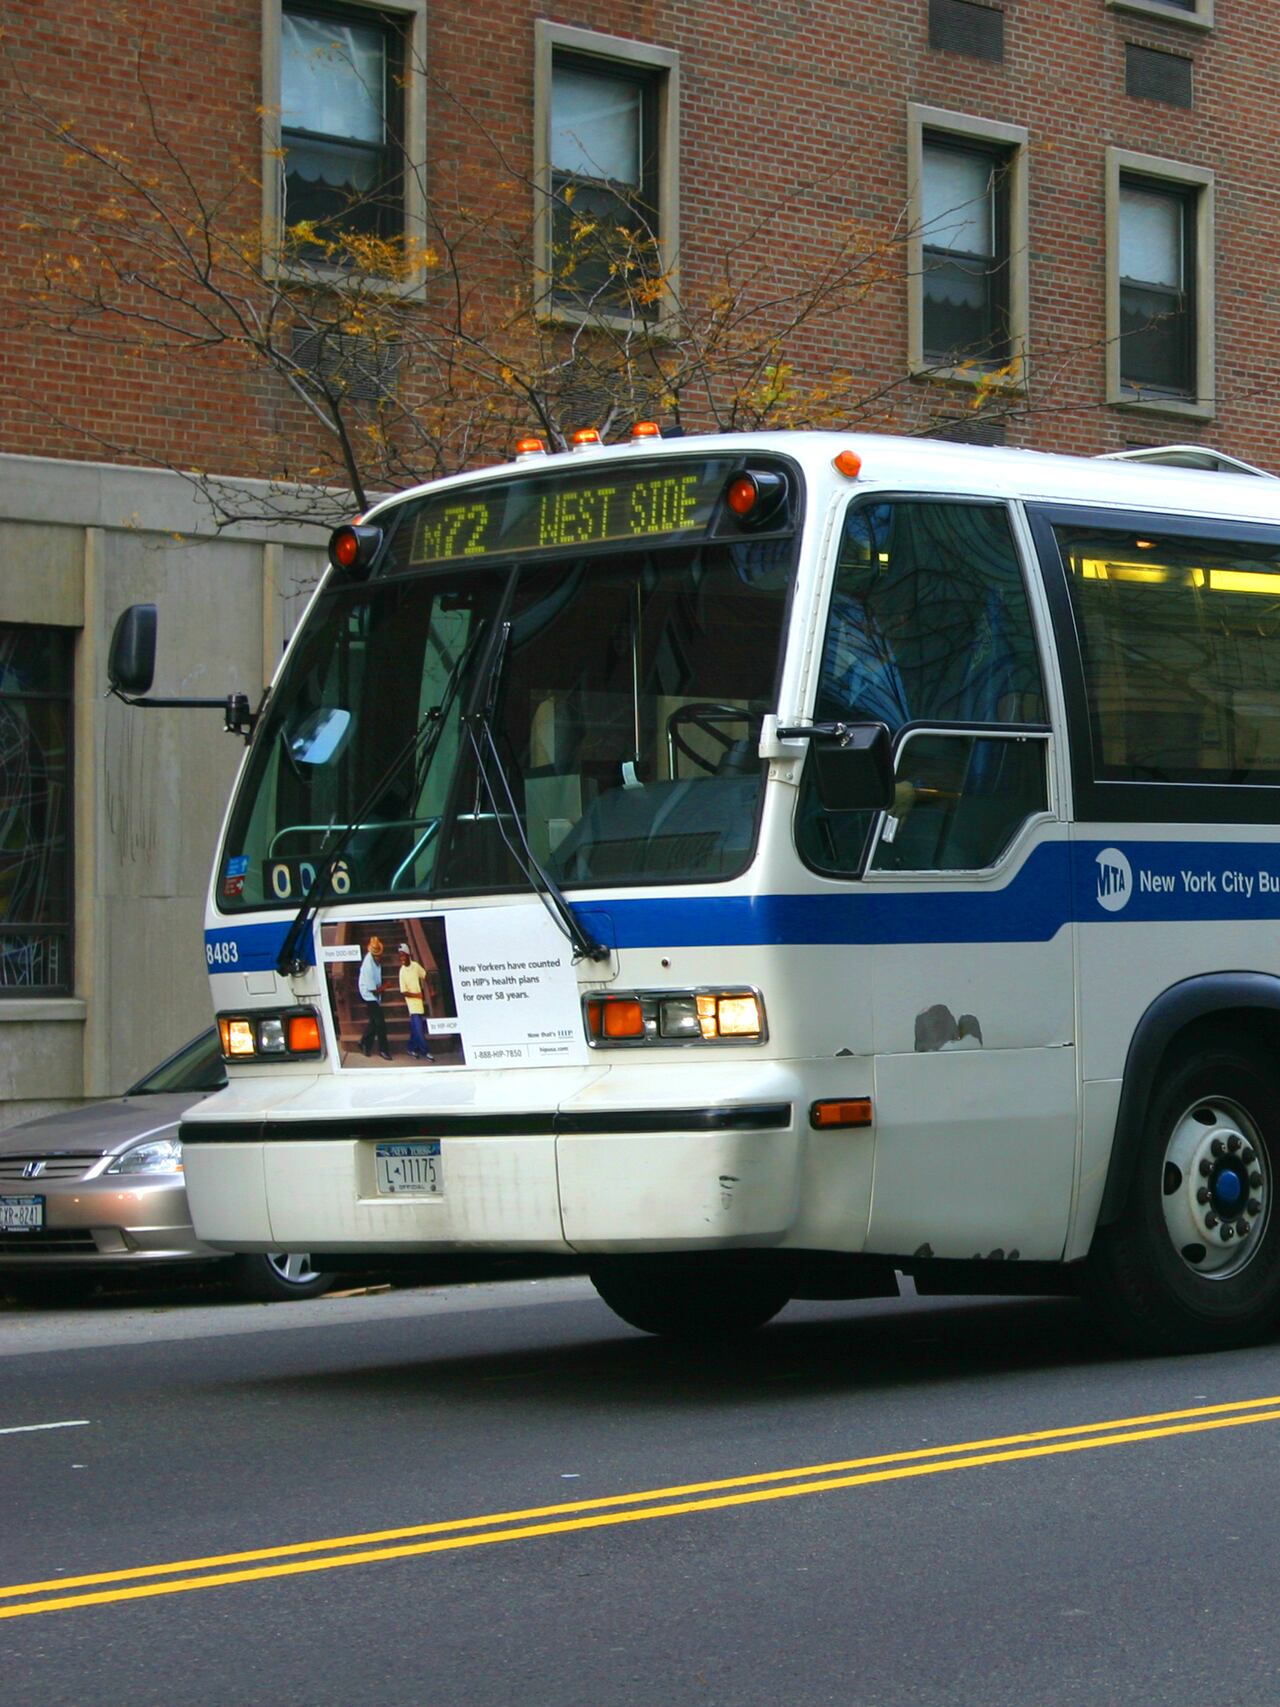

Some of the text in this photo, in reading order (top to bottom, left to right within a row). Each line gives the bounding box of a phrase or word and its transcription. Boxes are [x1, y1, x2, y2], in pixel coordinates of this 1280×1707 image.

[423, 475, 697, 559] M72 WEST SIDE
[1096, 862, 1126, 897] MTA
[1139, 870, 1176, 893] New
[1180, 870, 1217, 893] York
[1221, 870, 1254, 898] City
[206, 941, 239, 965] 8483
[458, 958, 561, 973] New Yorkers have counted
[472, 978, 490, 987] HIP's
[492, 976, 517, 986] health
[519, 975, 540, 986] plans
[463, 991, 529, 1001] for over 58 years.
